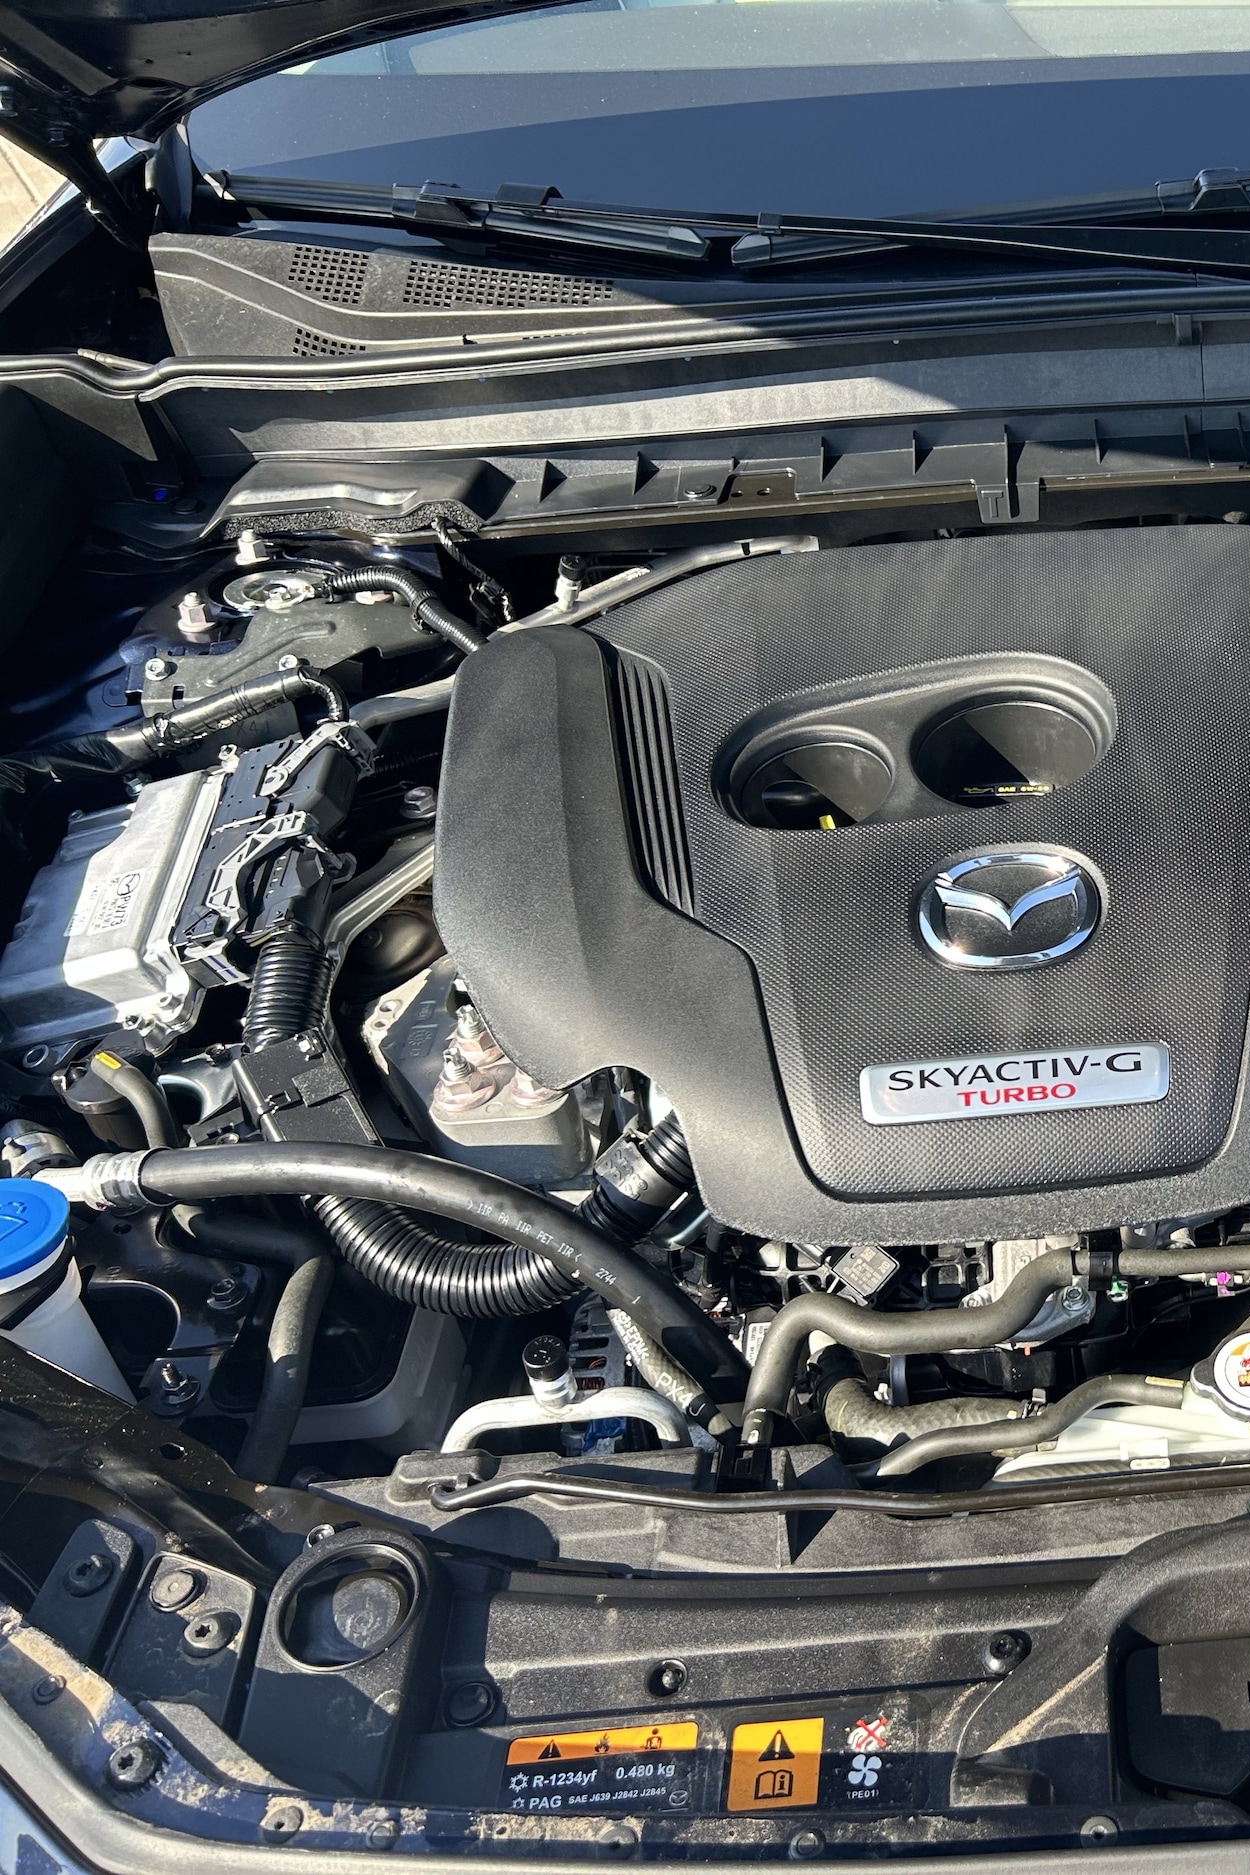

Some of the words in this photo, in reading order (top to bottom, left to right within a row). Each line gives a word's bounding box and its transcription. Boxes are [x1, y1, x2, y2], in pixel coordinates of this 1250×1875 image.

[888, 1051, 1143, 1092] SKYACTIV-G
[957, 1082, 1077, 1107] TURBO
[497, 1211, 510, 1226] PA
[536, 1230, 554, 1246] PET
[655, 1372, 706, 1417] PX4J
[533, 1769, 598, 1789] R-1234yf
[615, 1764, 654, 1780] 0.480
[656, 1763, 676, 1778] kg
[529, 1795, 562, 1810] PAG
[568, 1795, 588, 1805] SAE
[590, 1791, 611, 1803] J639
[612, 1789, 639, 1800] J2842
[640, 1786, 667, 1797] J2845
[846, 1789, 880, 1799] (PE01)
